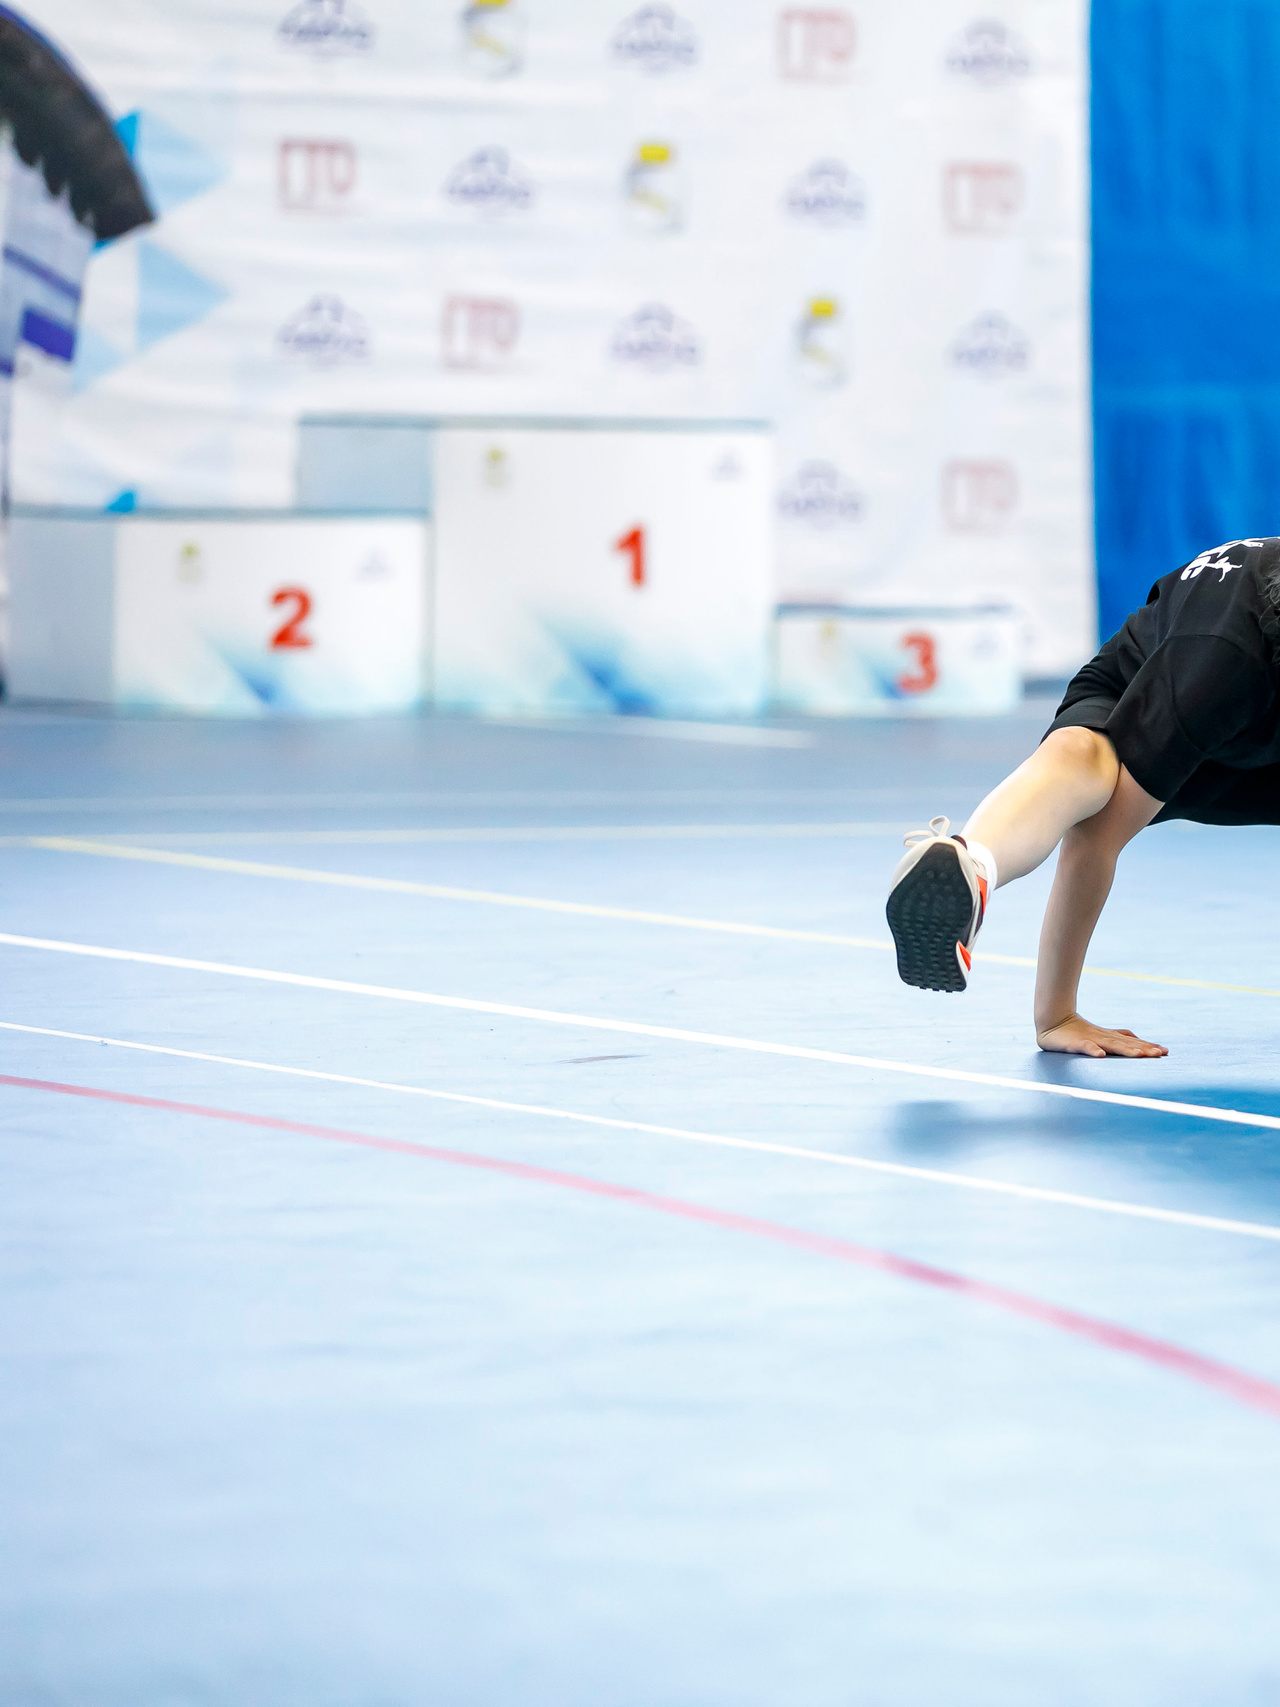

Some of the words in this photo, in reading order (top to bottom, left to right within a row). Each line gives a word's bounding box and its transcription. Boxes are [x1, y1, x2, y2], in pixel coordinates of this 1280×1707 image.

[614, 524, 646, 587] 1
[269, 586, 313, 650] 2
[899, 632, 938, 692] 3
